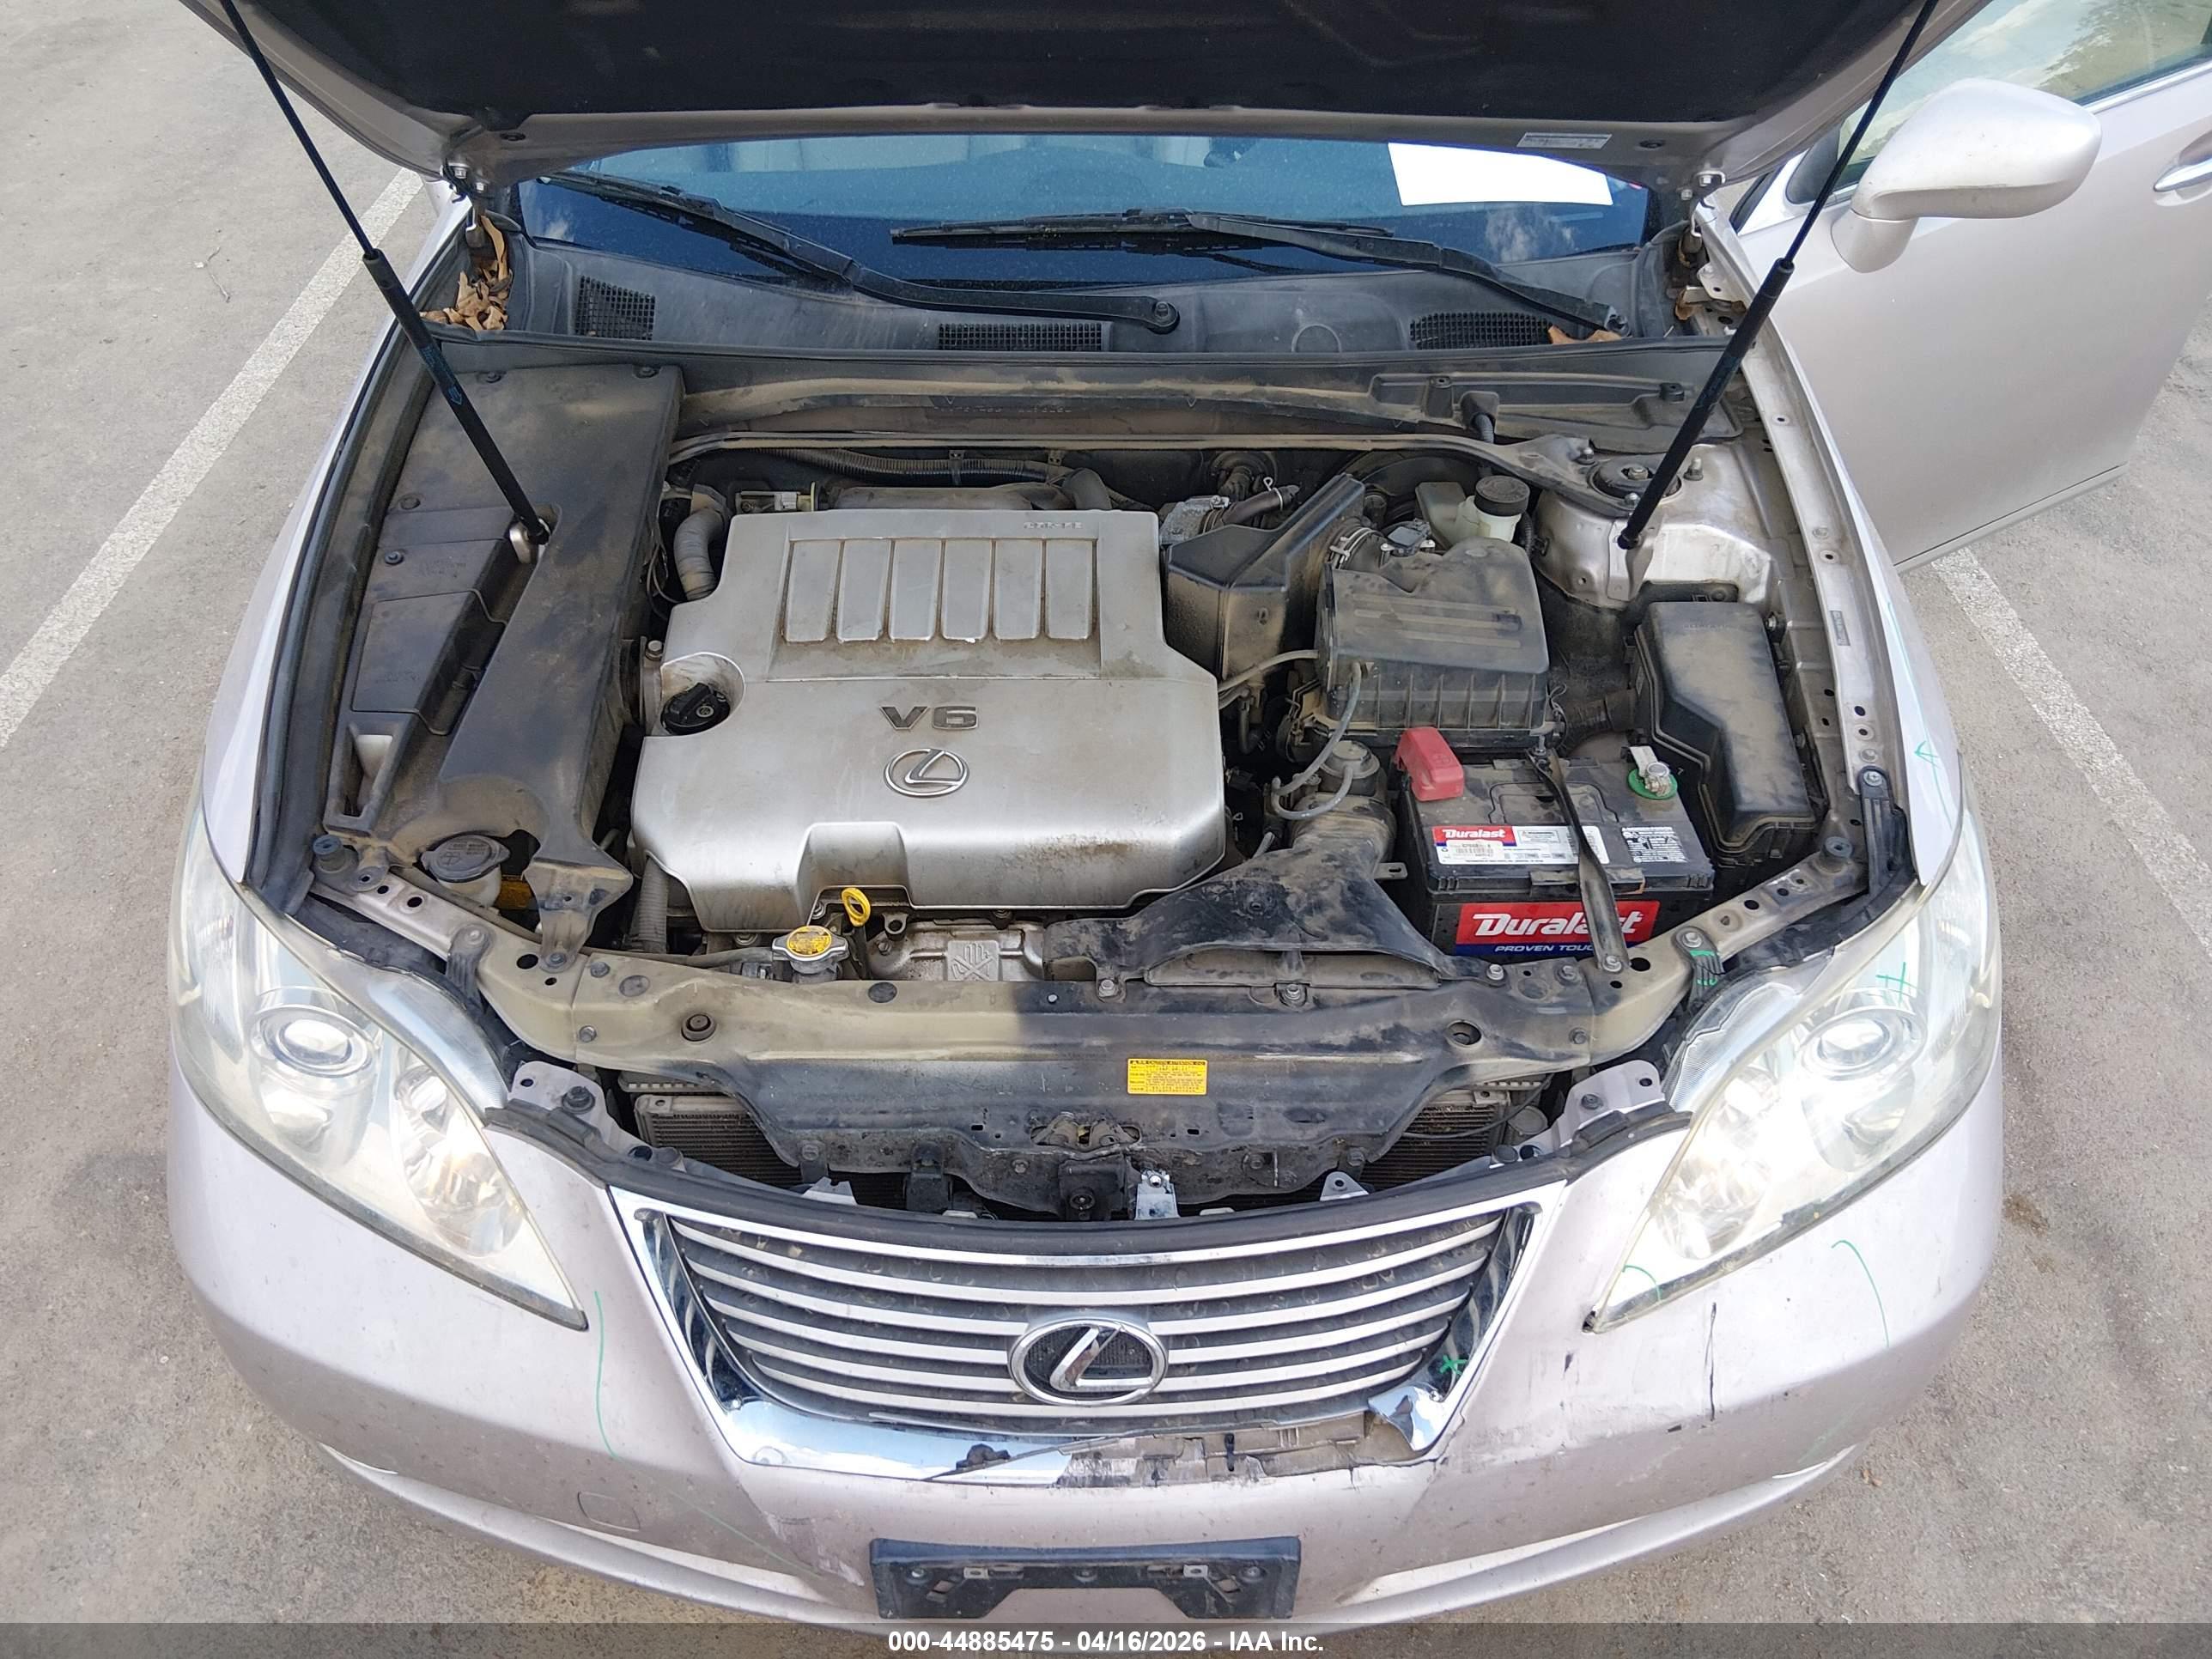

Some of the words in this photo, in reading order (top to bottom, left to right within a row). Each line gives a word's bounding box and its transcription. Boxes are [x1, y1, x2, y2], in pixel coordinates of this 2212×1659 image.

[879, 706, 979, 731] V6
[1442, 829, 1506, 839] Duralast
[1473, 911, 1644, 936] Duralat
